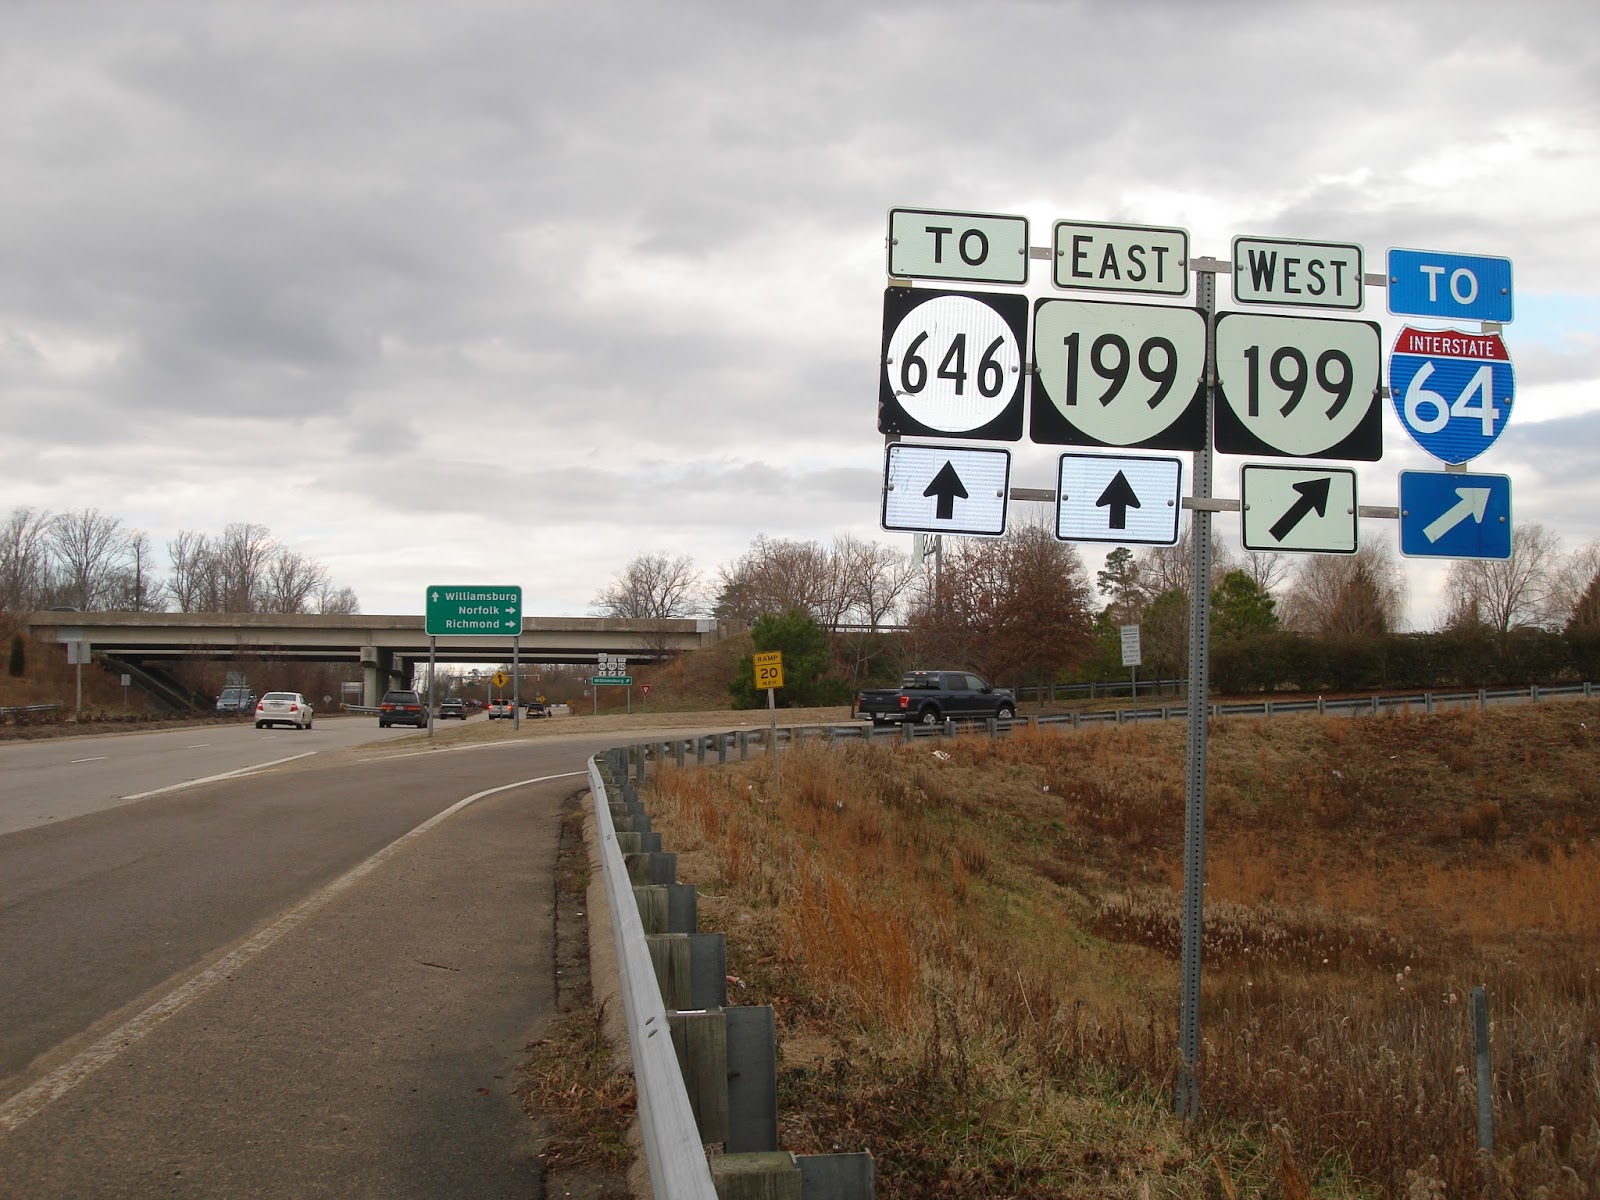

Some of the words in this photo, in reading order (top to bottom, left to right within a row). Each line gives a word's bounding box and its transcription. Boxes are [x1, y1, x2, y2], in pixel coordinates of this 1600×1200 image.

[925, 226, 989, 266] TO
[1071, 234, 1169, 283] EAST
[1248, 249, 1347, 297] WEST
[1420, 265, 1478, 305] TO
[900, 330, 1005, 398] 646
[1409, 335, 1494, 357] INTERSTATE
[1063, 332, 1178, 410] 199
[1244, 345, 1354, 421] 199
[1404, 361, 1500, 436] 64
[445, 592, 517, 603] Williamsburg
[458, 606, 499, 615] Norfolk
[446, 620, 499, 628] Richmond
[760, 667, 778, 679] 20
